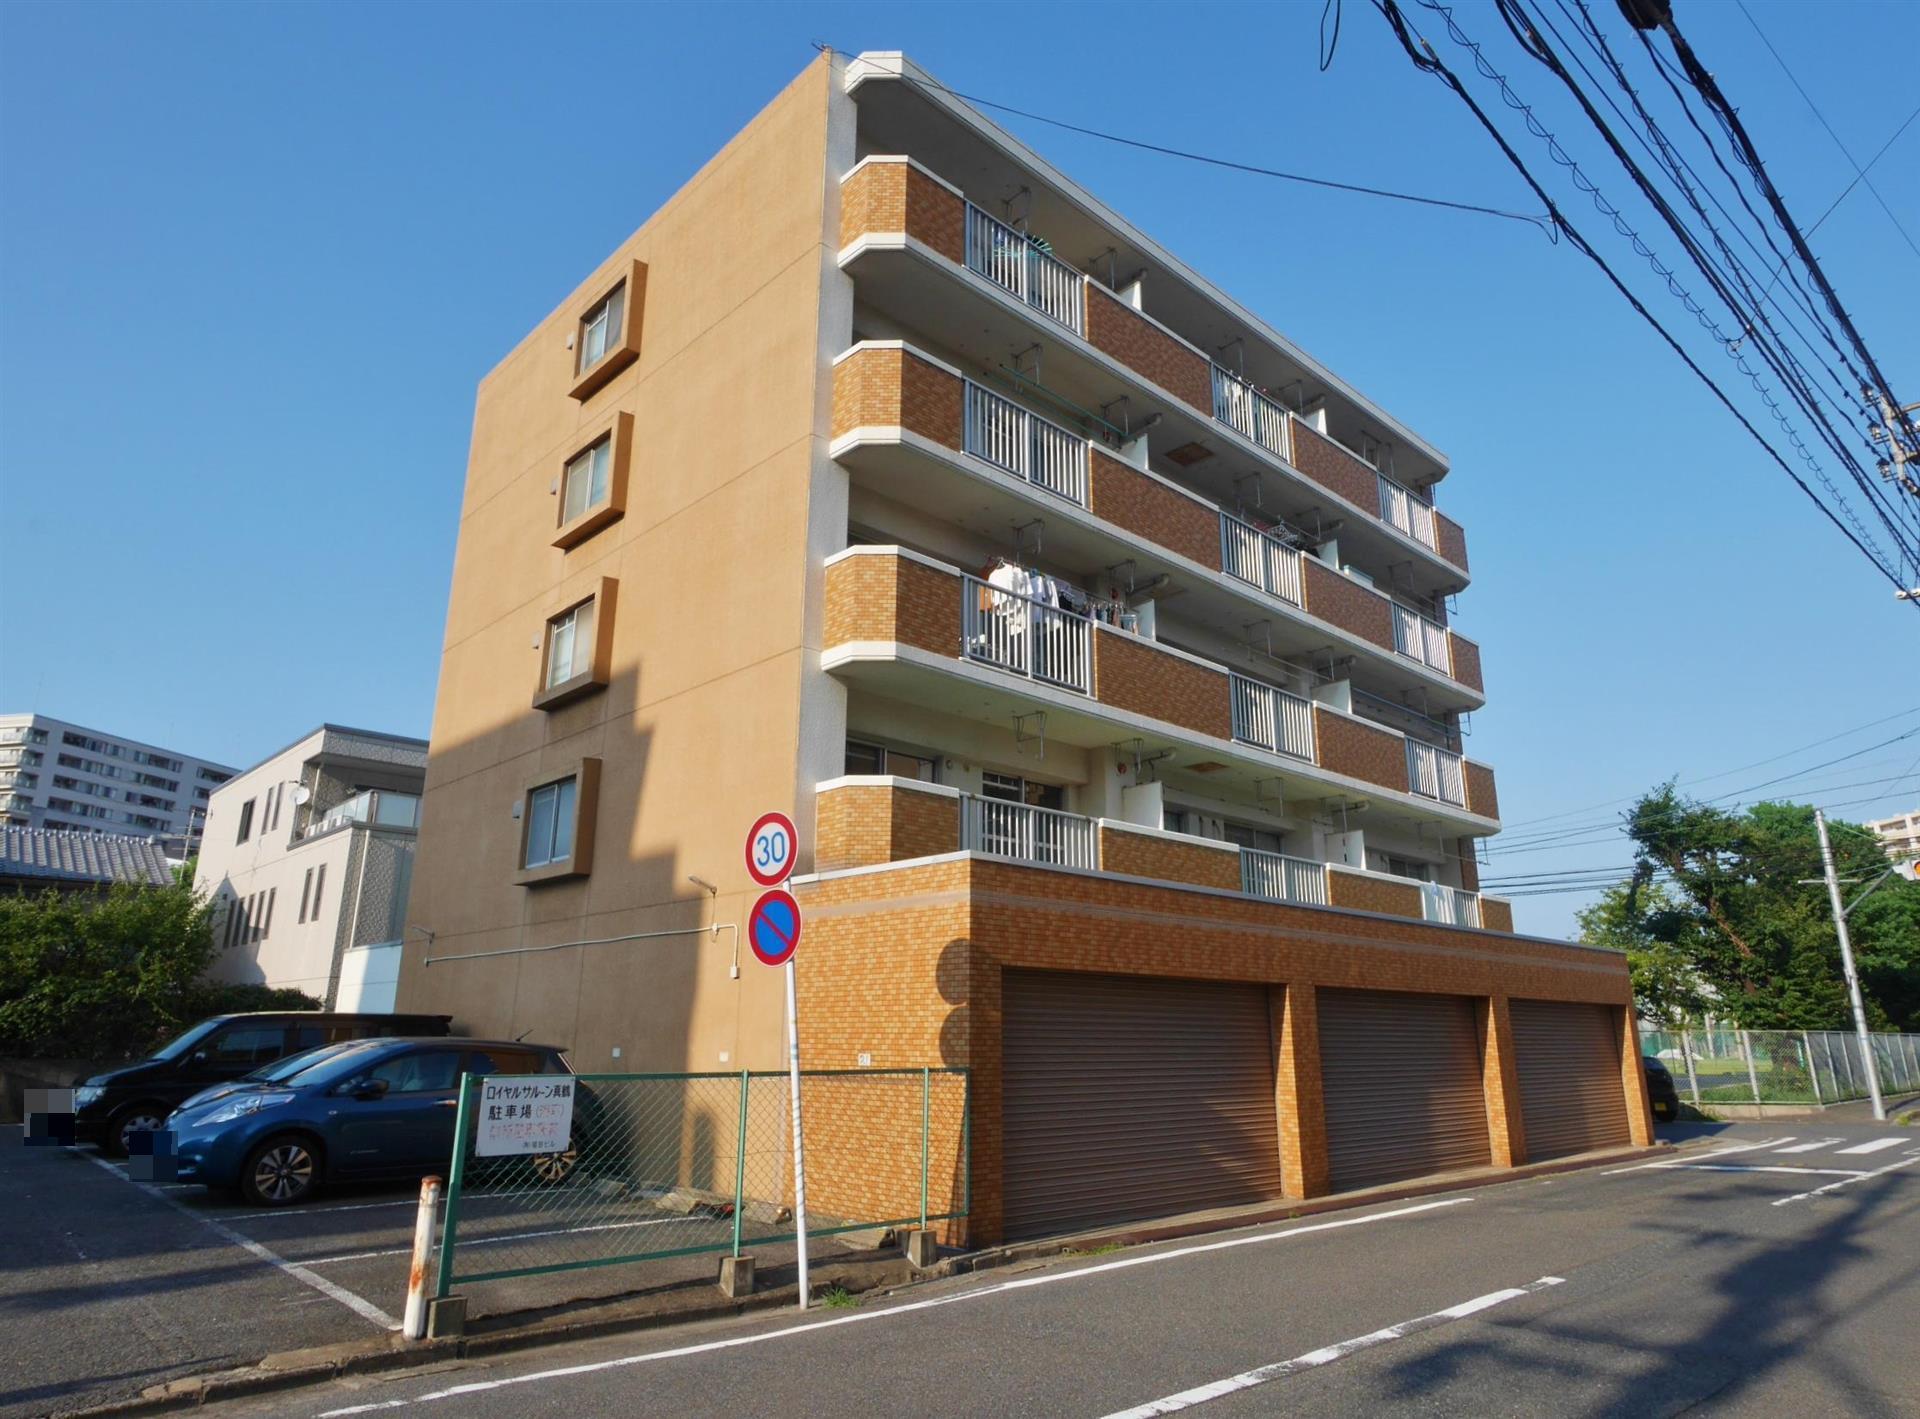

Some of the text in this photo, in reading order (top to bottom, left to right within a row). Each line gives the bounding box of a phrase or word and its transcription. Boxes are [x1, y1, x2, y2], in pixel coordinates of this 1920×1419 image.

[757, 832, 785, 867] 30
[488, 1104, 532, 1120] 駐車場
